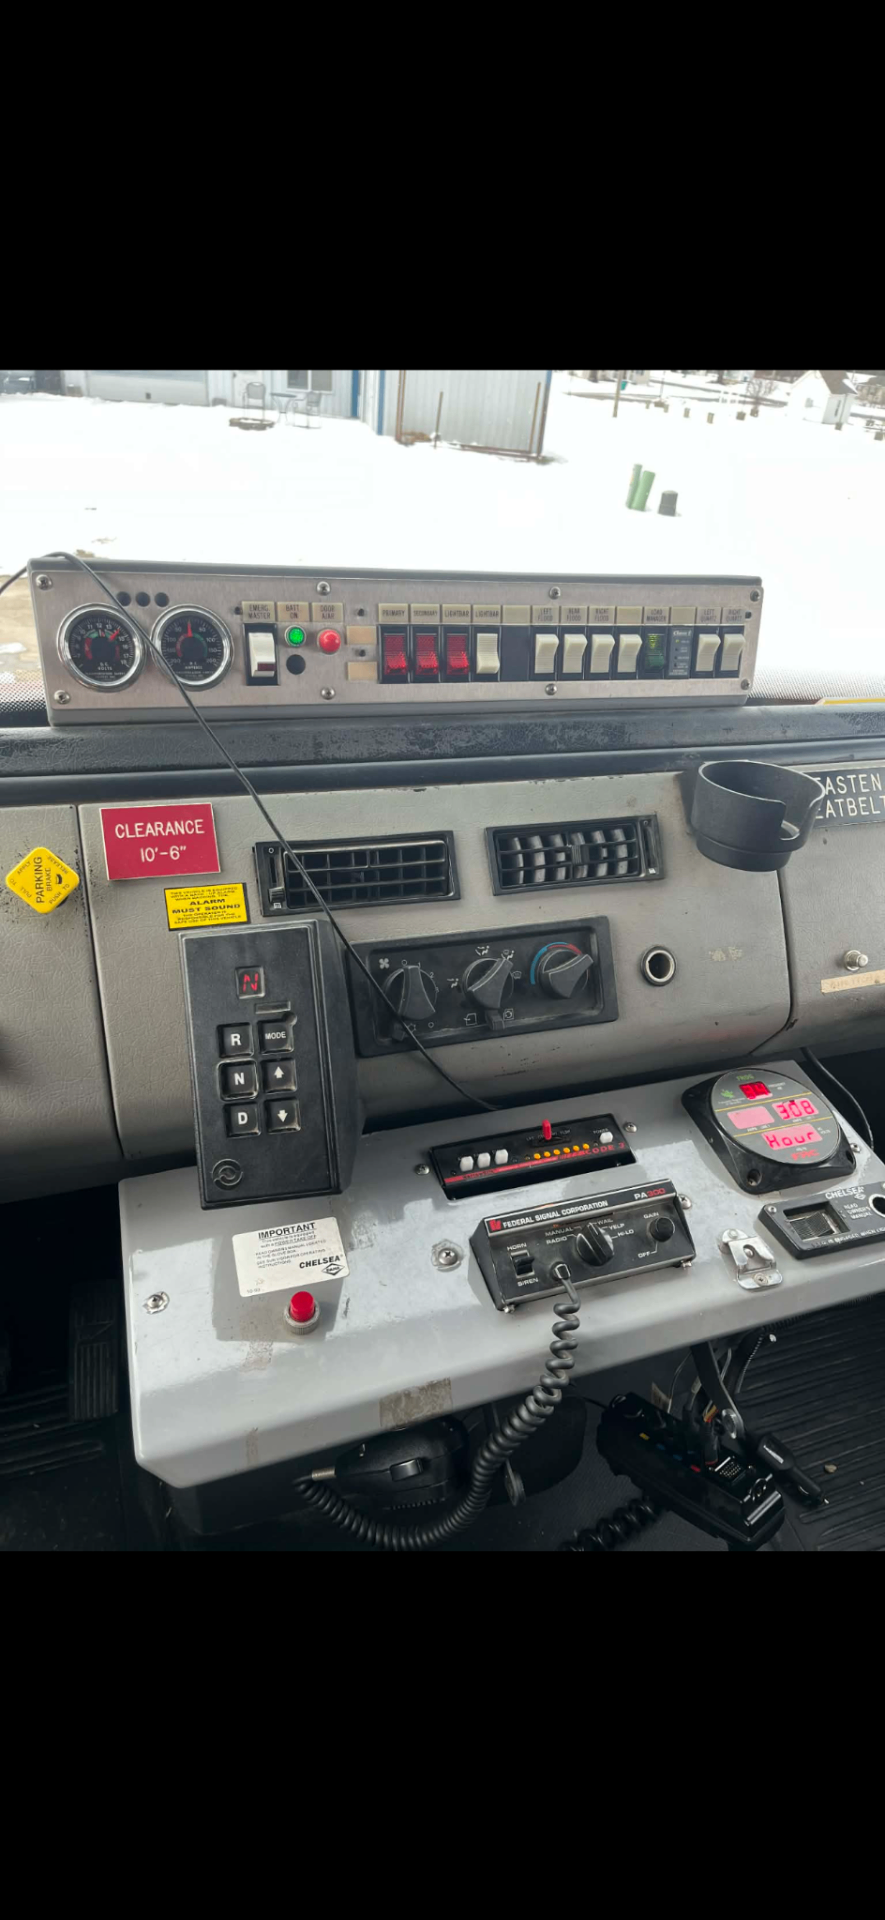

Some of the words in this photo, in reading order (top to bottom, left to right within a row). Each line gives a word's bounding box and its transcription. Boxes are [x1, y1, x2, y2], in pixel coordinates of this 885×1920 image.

[814, 772, 882, 795] ASTEN
[114, 819, 205, 839] CLEARANCE
[140, 845, 187, 863] 10'-6"
[17, 861, 31, 875] APPLY
[45, 854, 68, 875] RELEASE
[10, 878, 17, 886] TO
[33, 856, 45, 903] PARKING
[20, 886, 32, 898] PULL
[49, 891, 62, 904] PUSH
[190, 898, 226, 906] ALARM
[230, 1033, 241, 1046] R
[265, 1031, 286, 1040] MODE
[234, 1073, 245, 1085] N
[776, 1100, 815, 1120] 308
[238, 1112, 248, 1125] D
[765, 1132, 814, 1149] Hour
[585, 1144, 614, 1155] CODE
[634, 1188, 666, 1200] PA300
[825, 1186, 865, 1200] CHELSEA
[503, 1216, 534, 1229] FEDERAL
[535, 1211, 560, 1222] SIGNAL
[562, 1200, 609, 1216] CORPORATION
[258, 1222, 315, 1239] IMPORTANT
[545, 1227, 574, 1236] MANUAL
[507, 1242, 527, 1251] HORN
[546, 1236, 568, 1245] RADIO
[299, 1255, 341, 1269] CHELSEA
[517, 1278, 539, 1287] SIREN
